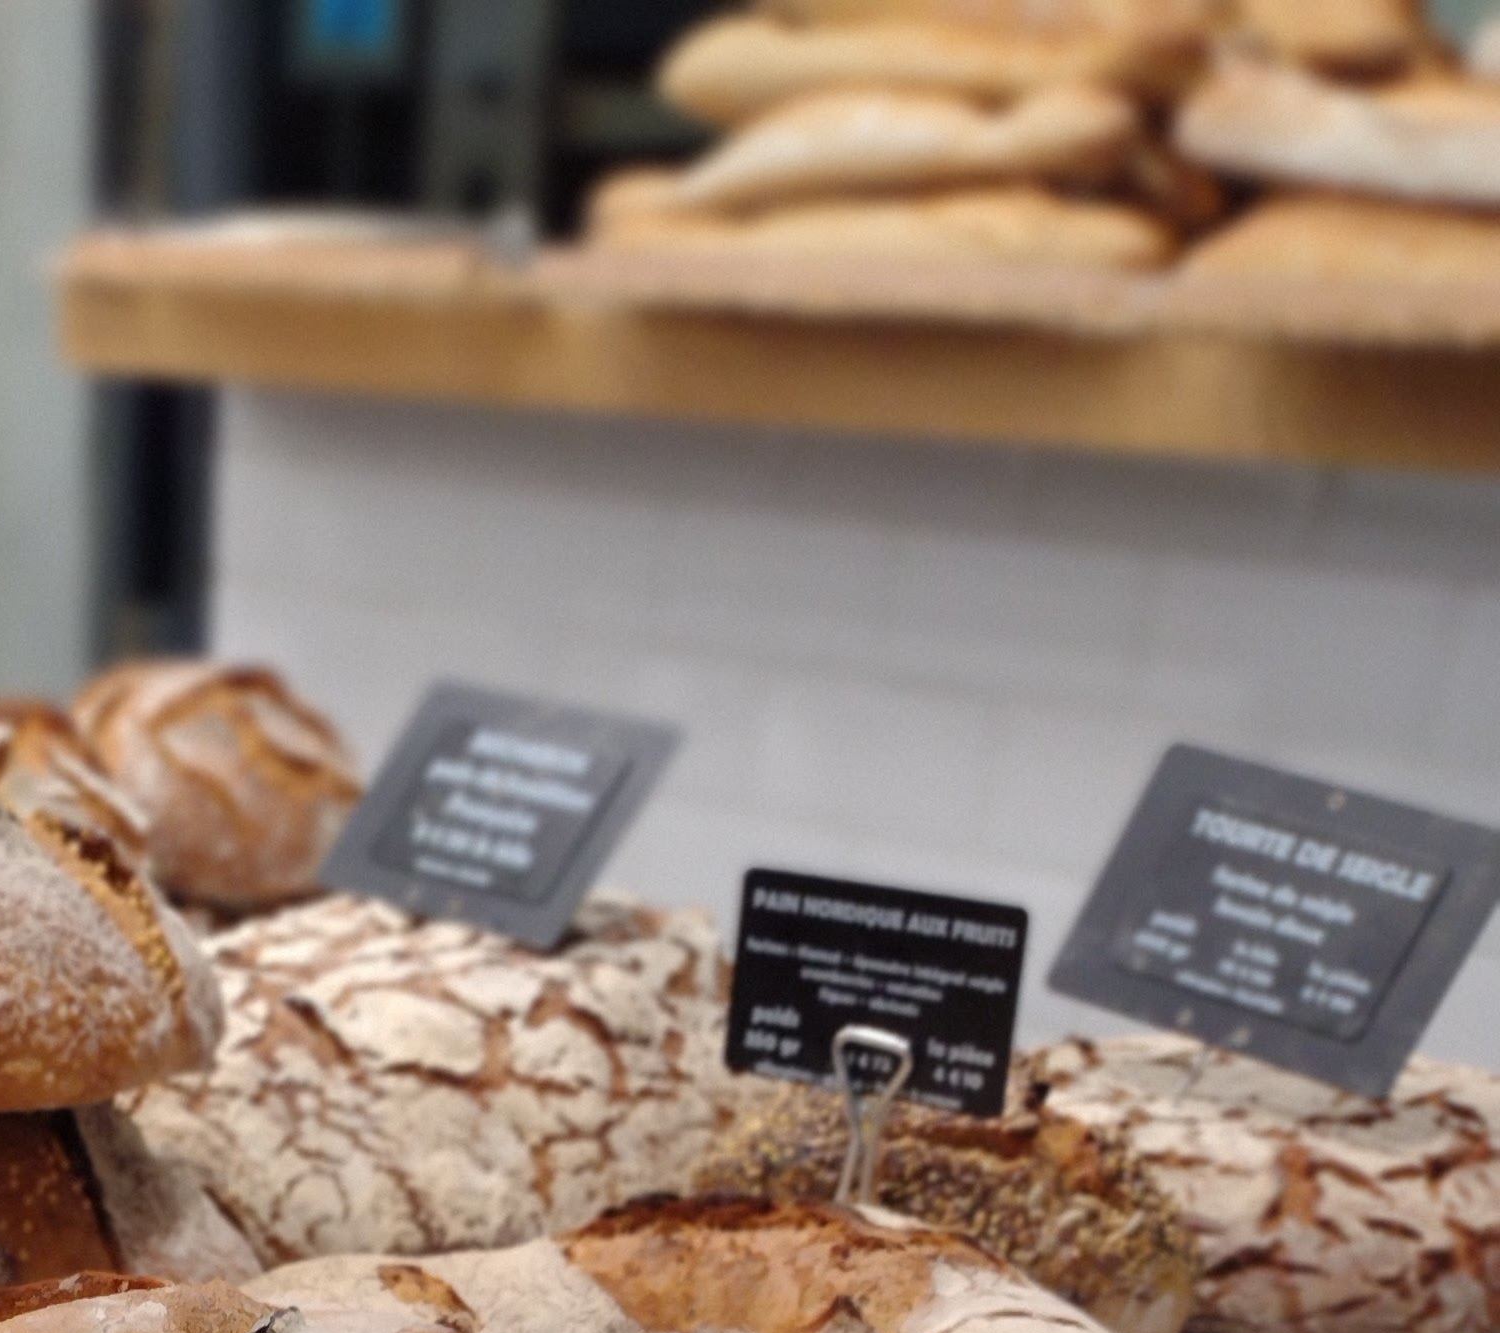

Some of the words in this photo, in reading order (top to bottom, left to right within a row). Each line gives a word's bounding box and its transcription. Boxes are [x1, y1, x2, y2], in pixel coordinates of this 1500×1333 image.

[1295, 841, 1338, 871] DE
[753, 889, 800, 912] PAIN
[802, 896, 904, 930] NORDIQUE
[906, 914, 948, 936] AUX
[952, 920, 1016, 947] FRUITS
